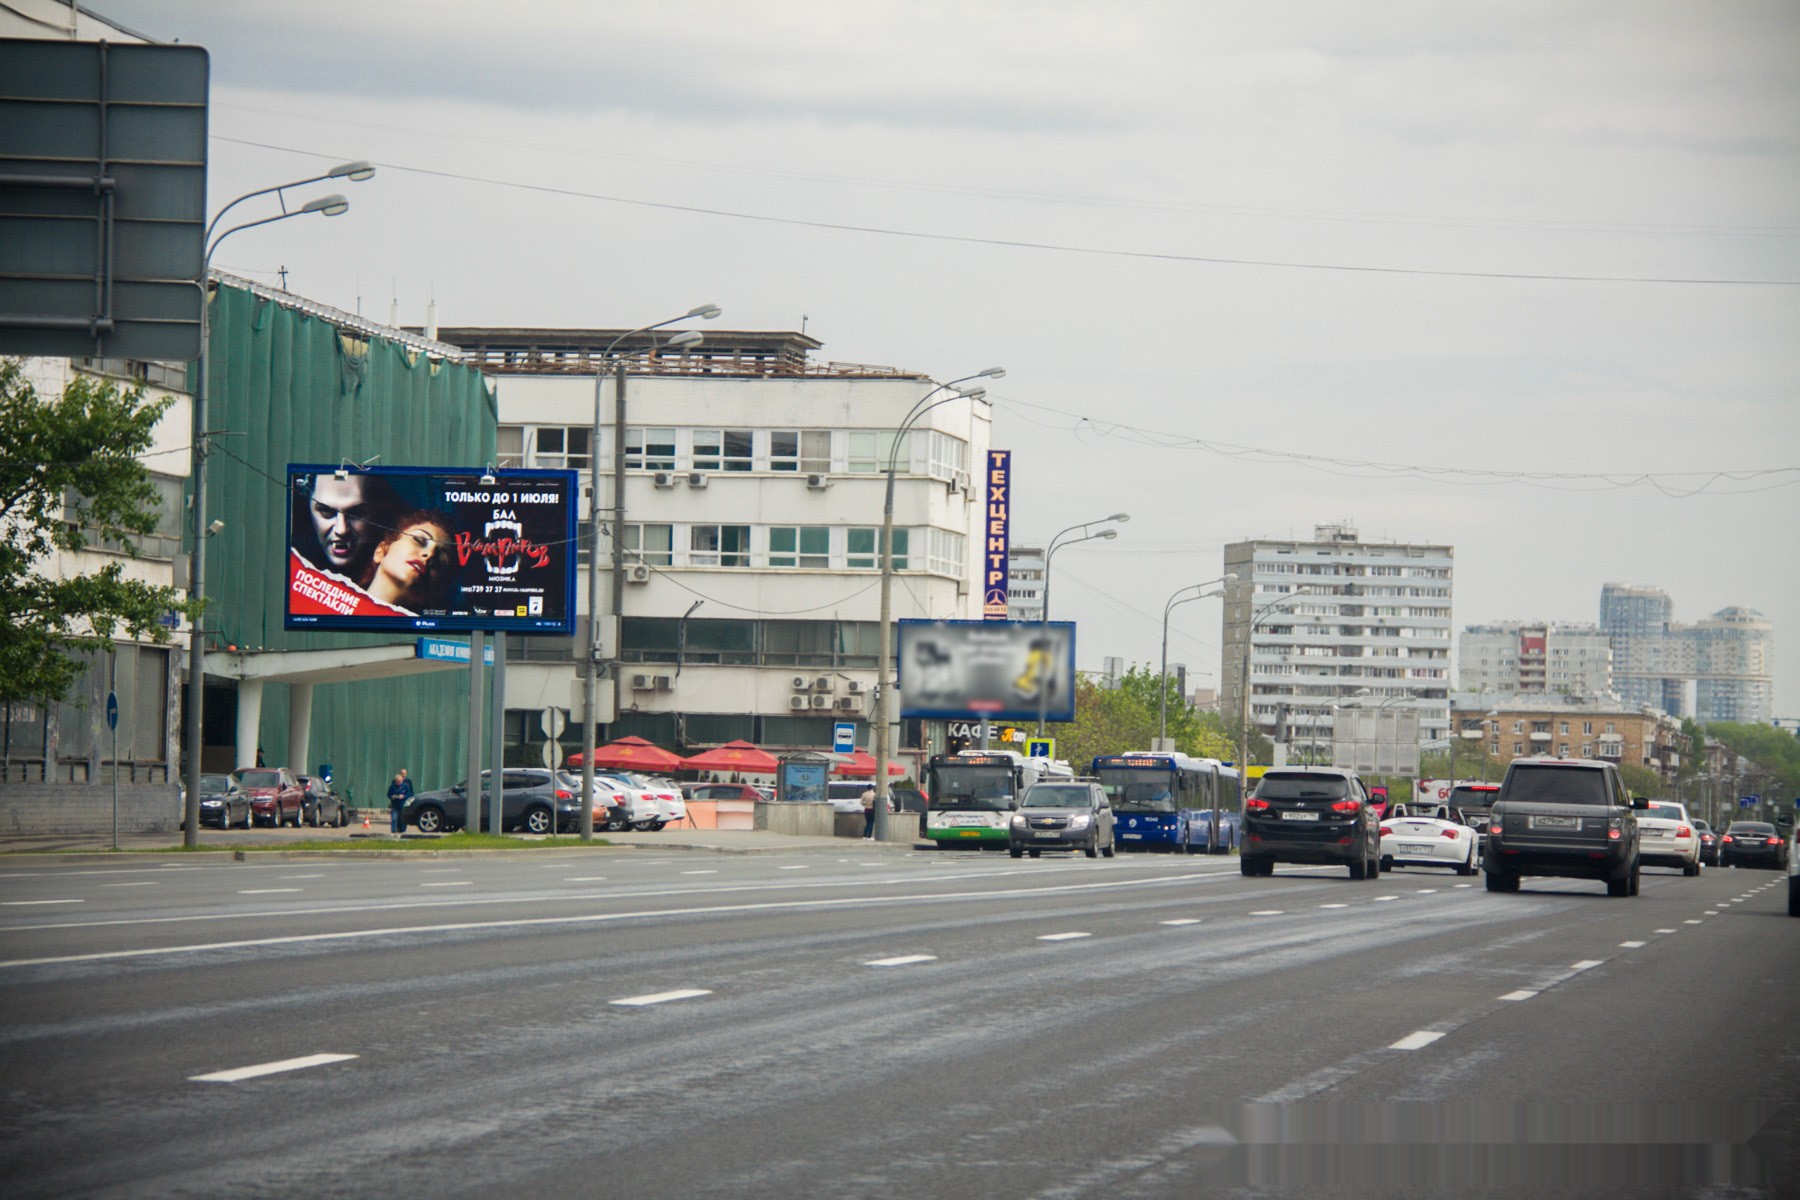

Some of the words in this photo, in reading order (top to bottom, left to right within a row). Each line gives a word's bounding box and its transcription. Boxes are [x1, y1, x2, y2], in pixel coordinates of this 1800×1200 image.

[445, 492, 490, 503] ТОЛЬКО
[492, 493, 510, 504] ДО
[513, 493, 517, 503] 1
[521, 494, 559, 504] ИЮЛЯ!
[493, 509, 516, 520] БАЛ
[987, 453, 1007, 586] ТЕХЦЕНТР
[292, 581, 355, 615] СПЕКТАКЛИ
[295, 570, 360, 608] ПОСЛЕДНИЕ
[947, 723, 998, 740] КАФЕ
